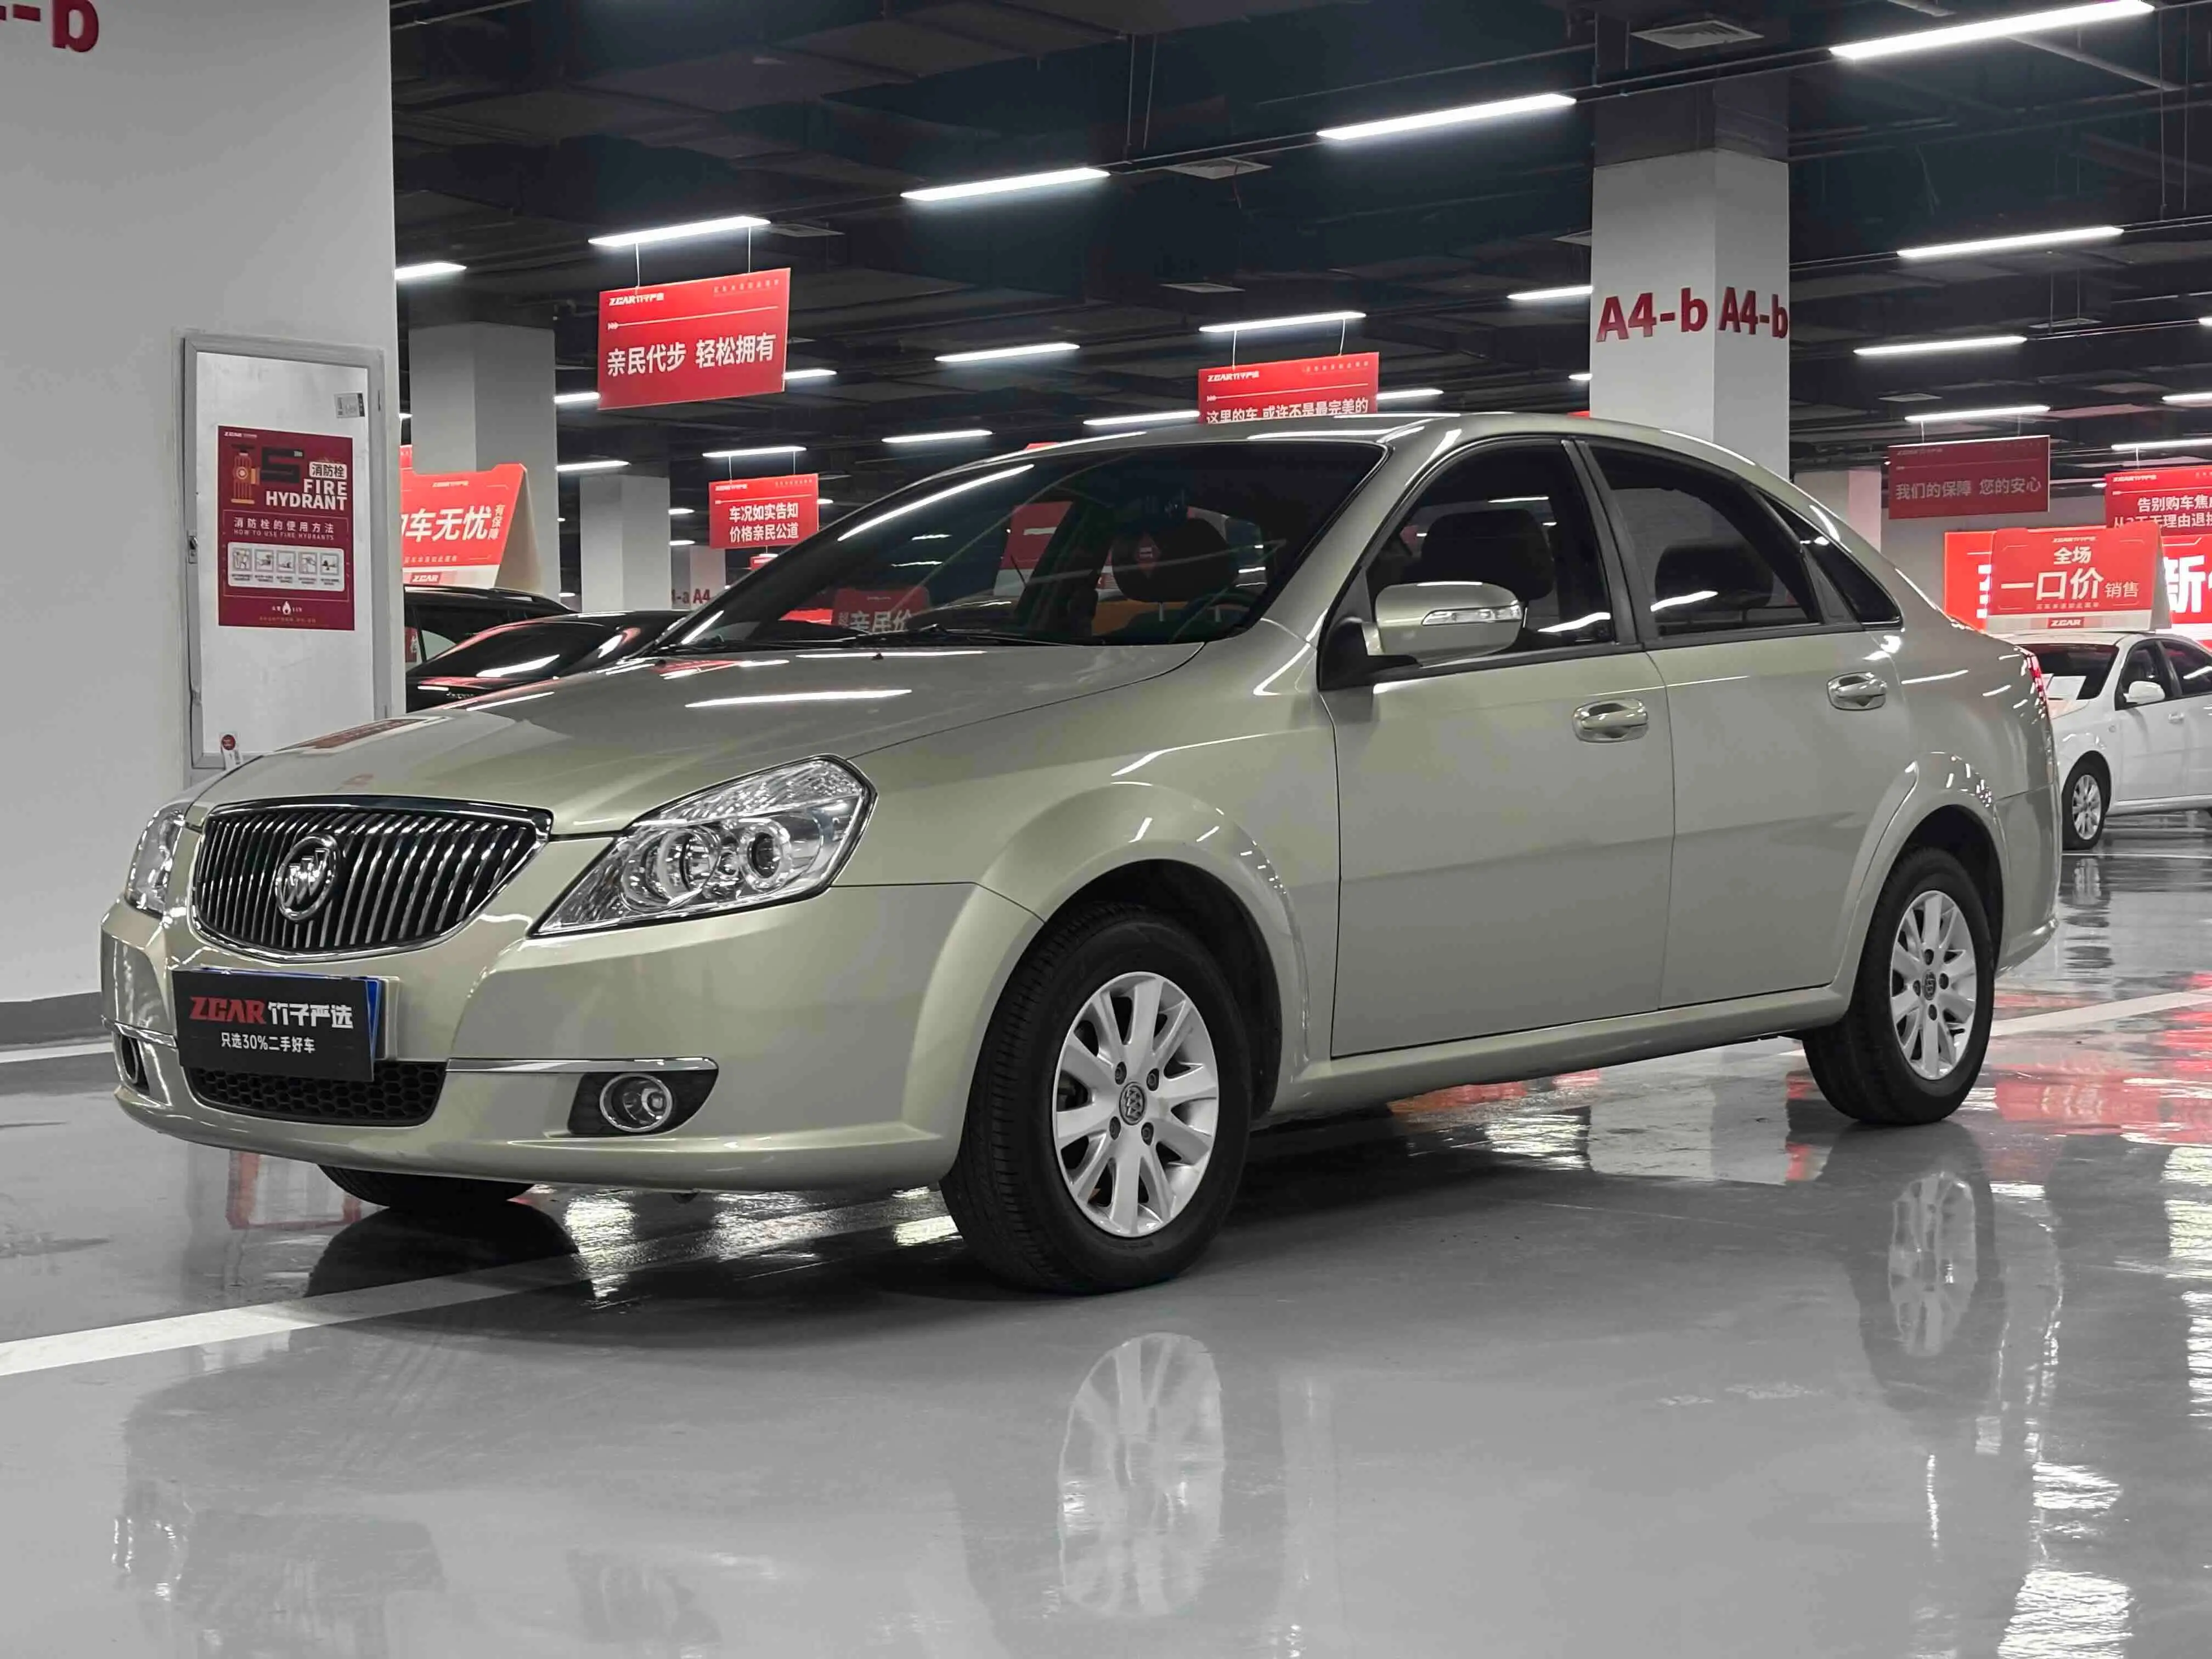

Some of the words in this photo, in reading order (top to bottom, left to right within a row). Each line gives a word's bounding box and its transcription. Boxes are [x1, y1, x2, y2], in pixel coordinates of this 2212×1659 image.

[0, 0, 99, 52] -b
[1596, 287, 1708, 342] A4-b
[1718, 286, 1788, 339] A4-b
[607, 342, 686, 377] 亲民代步
[695, 332, 777, 368] 轻松拥有
[1207, 409, 1257, 424] 这里的车
[312, 463, 345, 477] 消防栓
[303, 478, 347, 496] FIRE
[1896, 481, 1972, 500] 我们的保障
[1979, 477, 2041, 494] 您的安心
[266, 491, 347, 510] HYDRANT
[2137, 494, 2212, 512] 告别购车焦
[729, 503, 799, 523] 车况如实告知
[730, 522, 799, 543] 价格亲民公道
[2053, 546, 2092, 565] 全场
[2001, 567, 2104, 600] 一口价
[2104, 582, 2140, 598] 销售
[2163, 555, 2212, 613] 新
[189, 996, 267, 1025] ZCAR
[268, 1001, 354, 1029] 竹子严选
[221, 1032, 316, 1053] 只选30%二手好车
